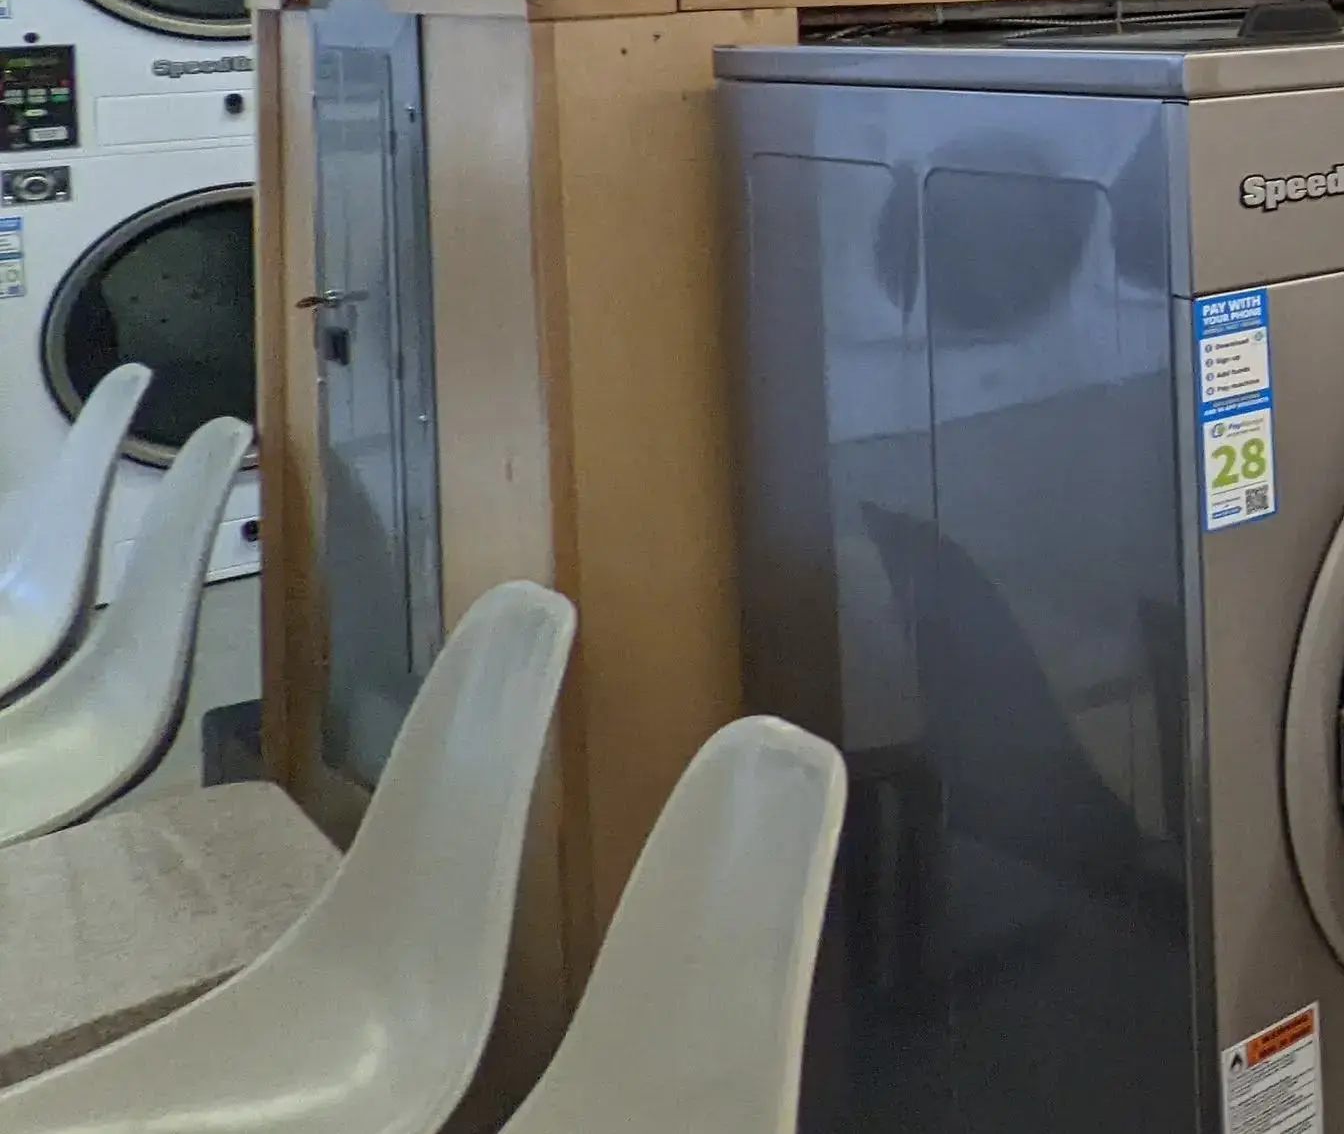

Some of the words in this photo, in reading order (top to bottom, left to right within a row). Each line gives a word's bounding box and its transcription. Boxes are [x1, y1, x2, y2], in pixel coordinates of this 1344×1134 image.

[1202, 302, 1226, 317] PAY
[1228, 295, 1261, 312] WITH
[1211, 437, 1267, 489] 28
